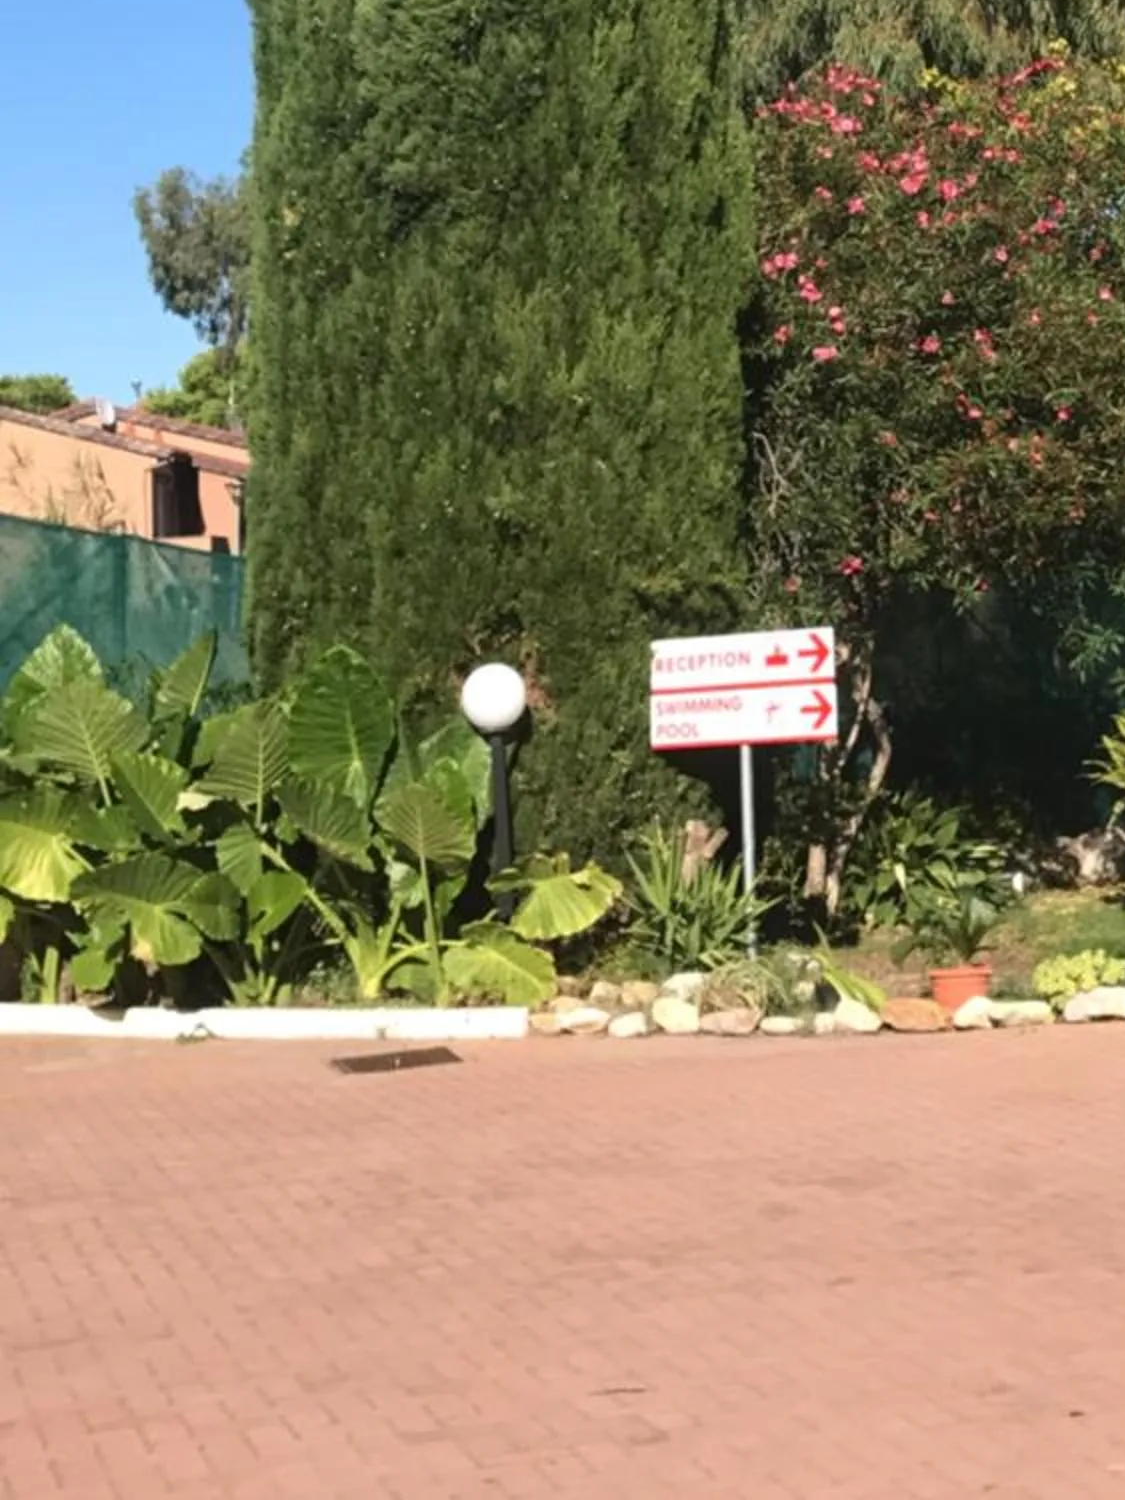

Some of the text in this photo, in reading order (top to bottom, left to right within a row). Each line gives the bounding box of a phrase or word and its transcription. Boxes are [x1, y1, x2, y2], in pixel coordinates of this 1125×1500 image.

[655, 652, 750, 672] RECEPTION
[656, 696, 742, 716] SWIMMING
[656, 723, 699, 738] POOL
